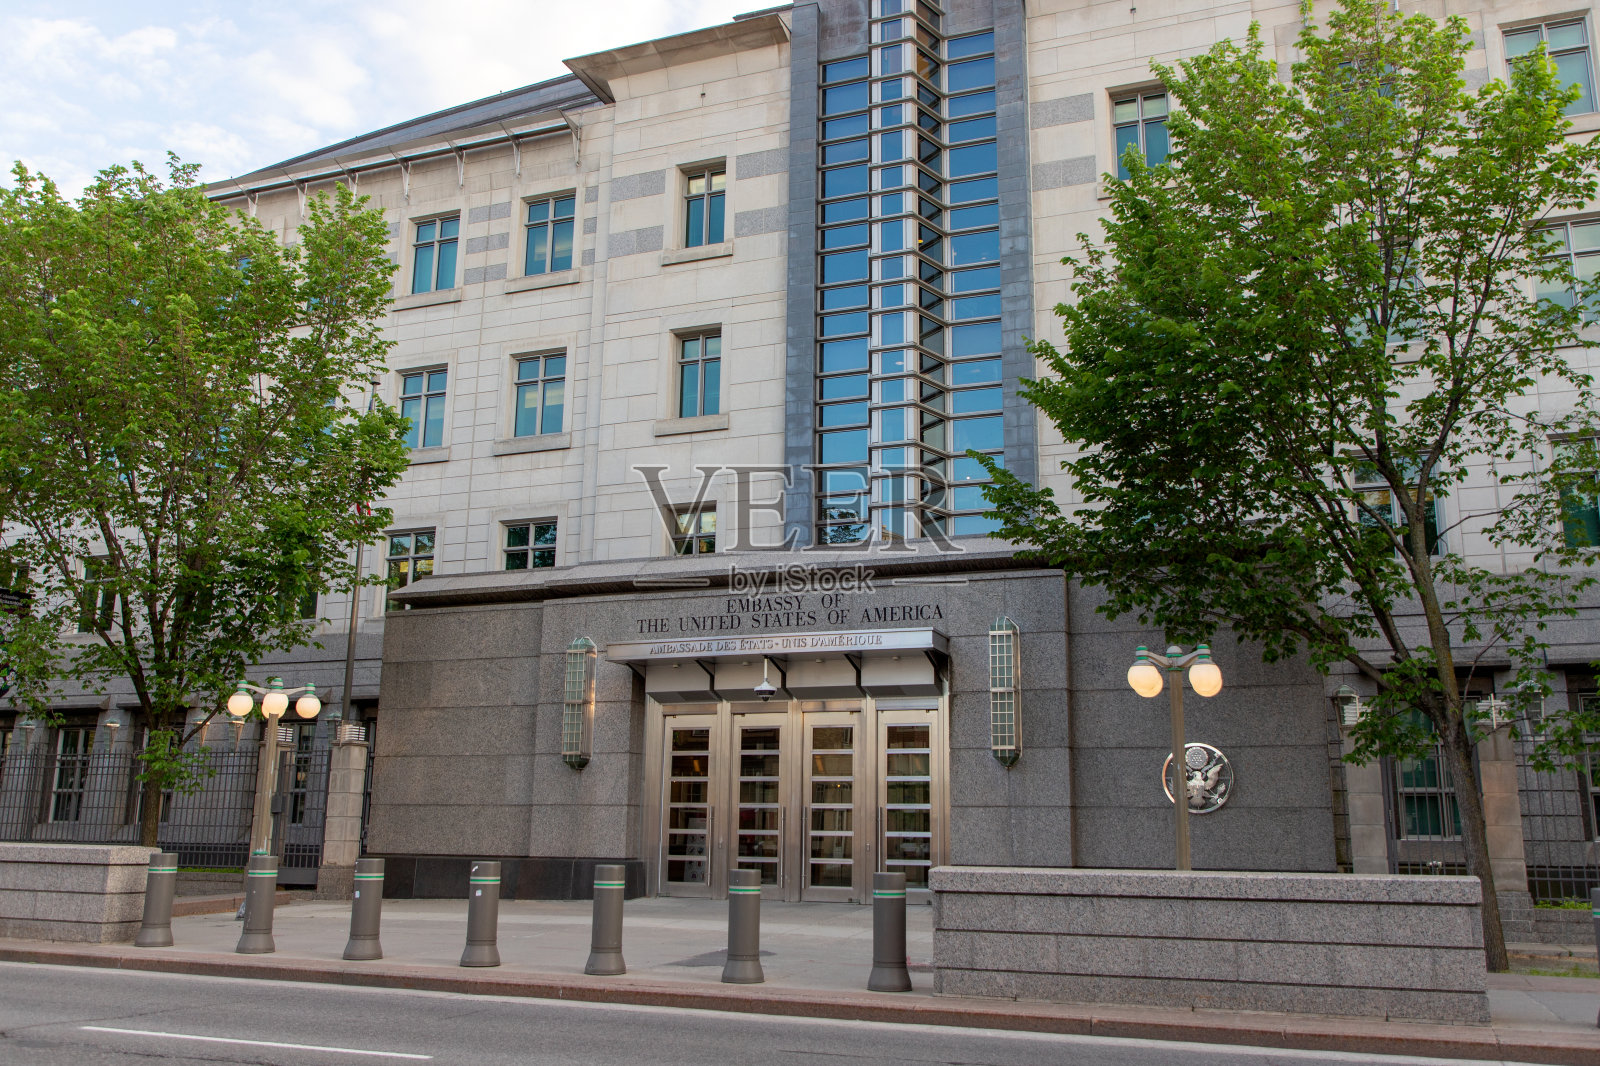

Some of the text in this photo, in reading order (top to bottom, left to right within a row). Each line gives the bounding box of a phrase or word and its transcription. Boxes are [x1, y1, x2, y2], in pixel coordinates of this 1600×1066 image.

[727, 593, 844, 613] EMBASSY OF
[637, 604, 943, 633] THE UNITED STATES OF AMERICA
[650, 641, 713, 654] AMBASSADE
[715, 640, 737, 652] DES
